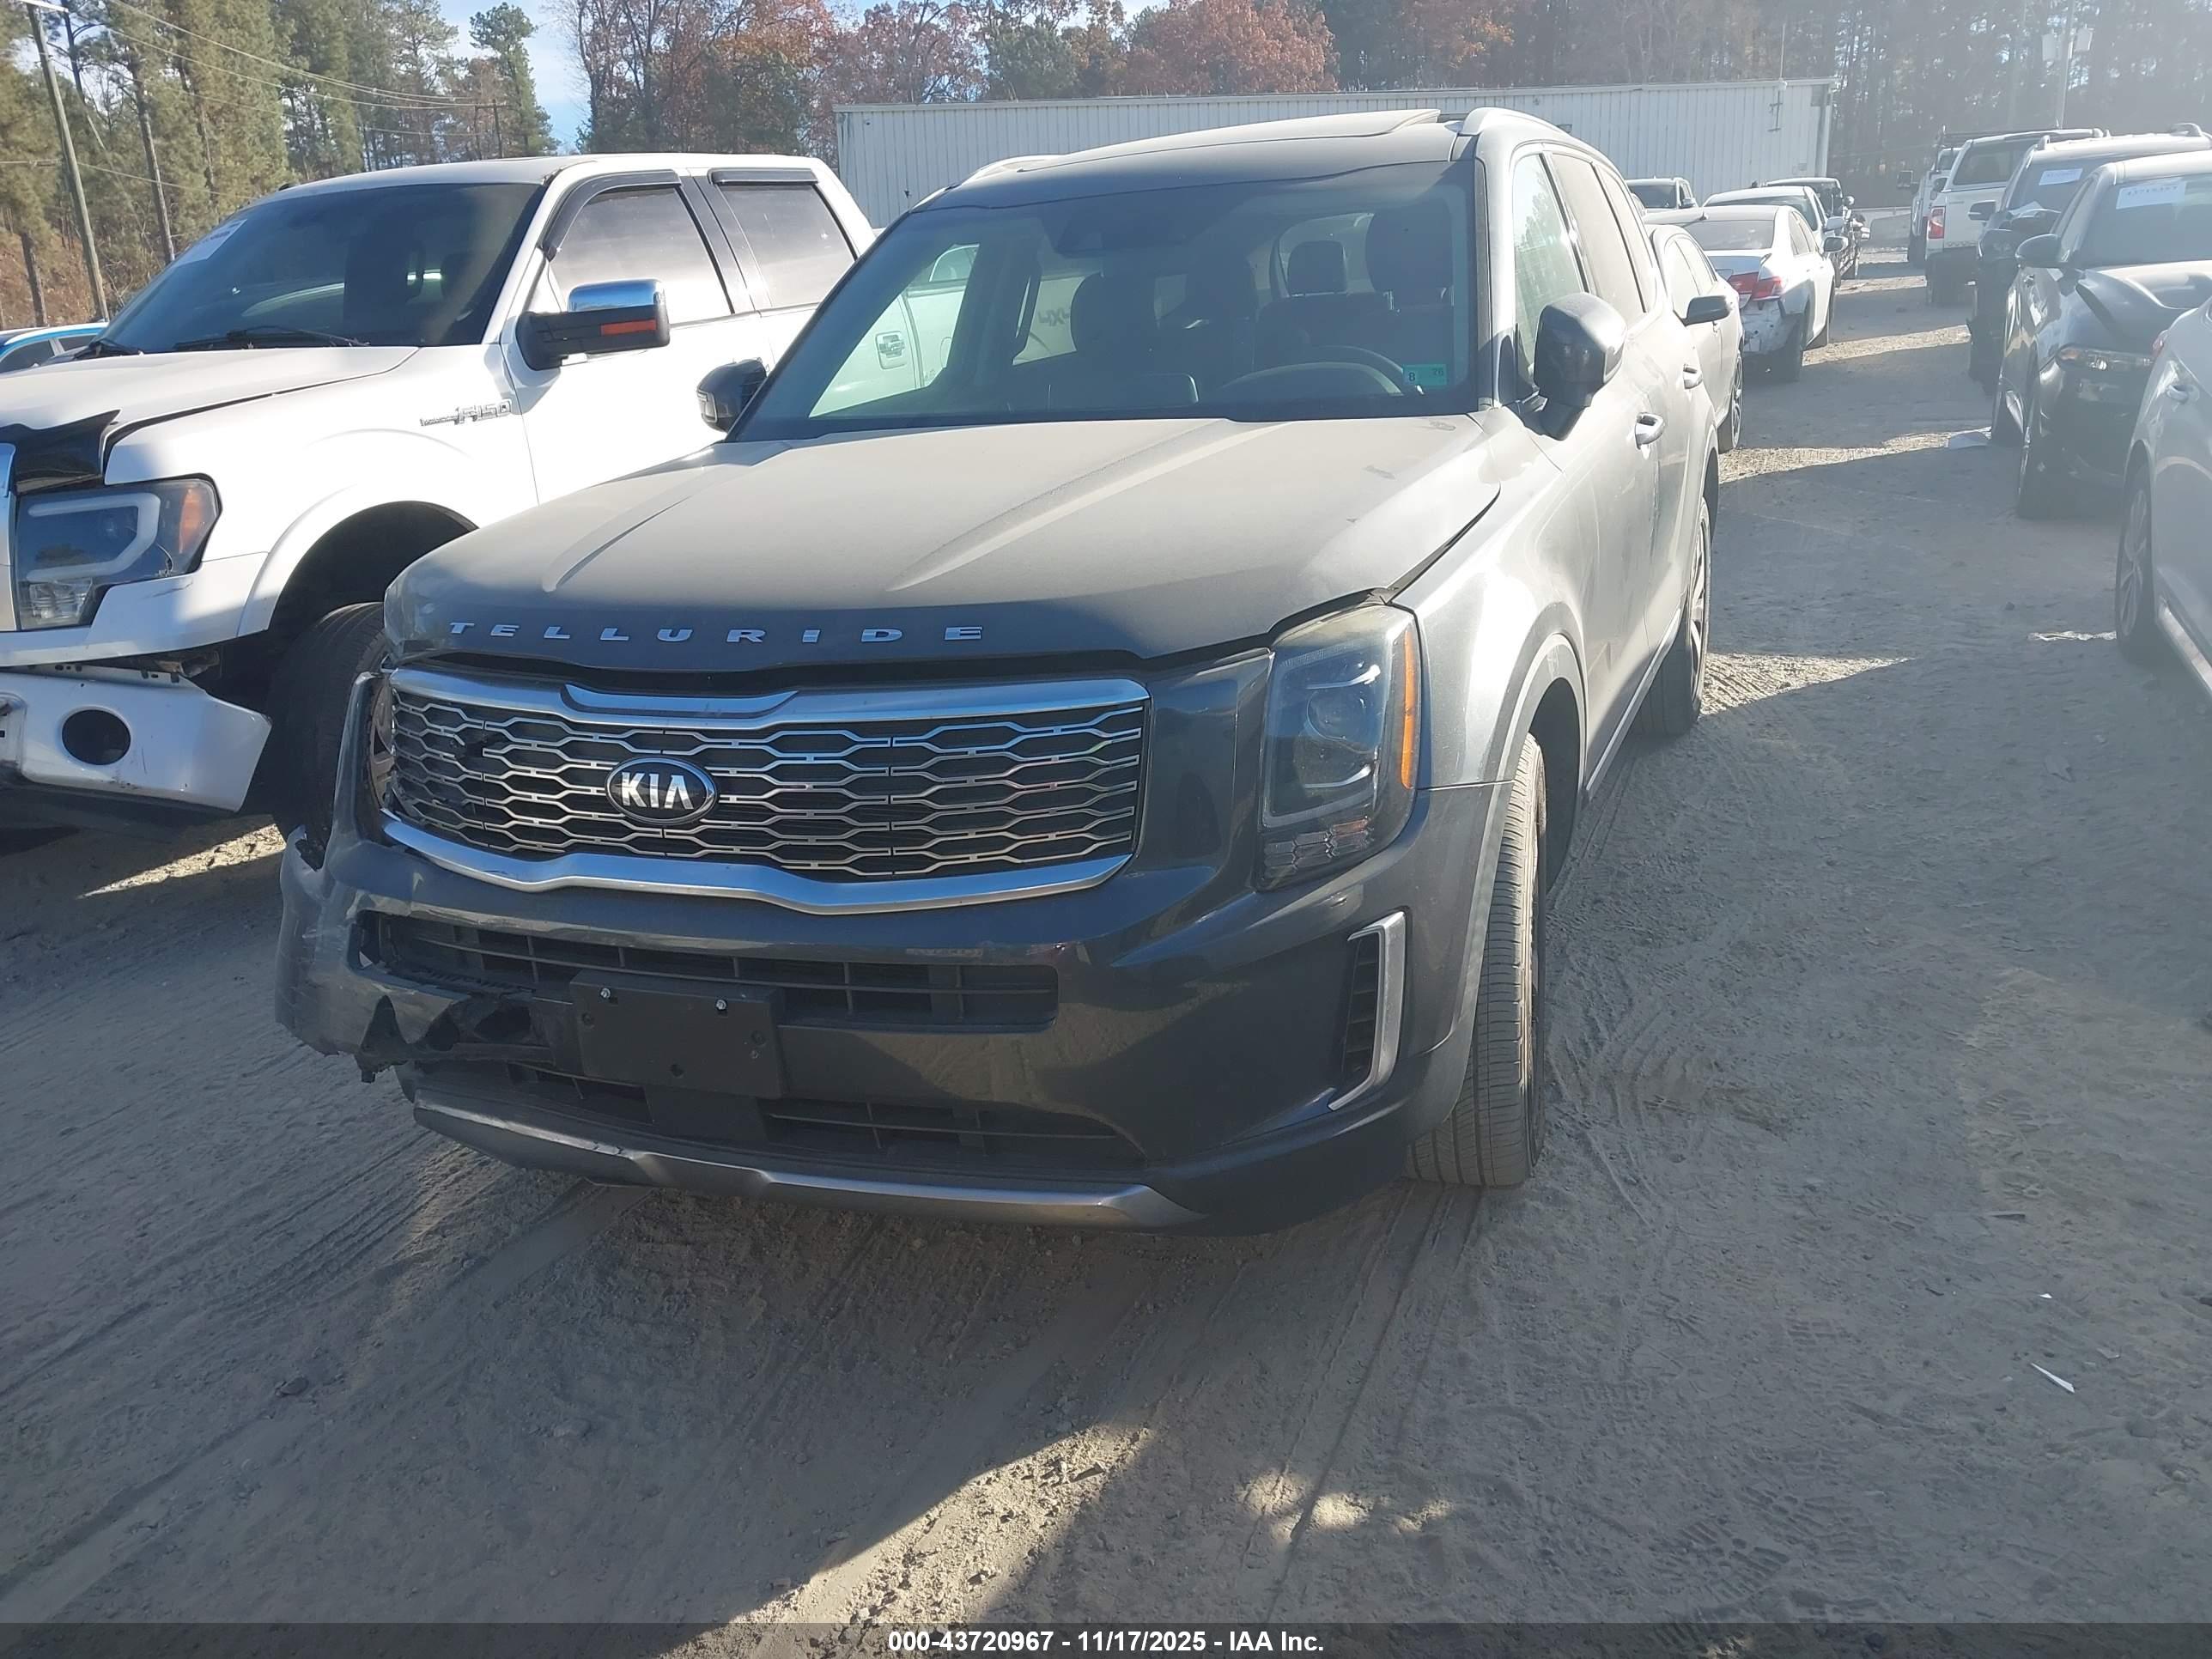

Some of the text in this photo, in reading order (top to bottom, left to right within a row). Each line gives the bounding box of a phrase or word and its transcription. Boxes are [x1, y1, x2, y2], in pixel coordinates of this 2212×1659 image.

[1408, 372, 1416, 382] 8
[449, 622, 983, 643] TELLURIDE
[621, 771, 695, 810] KIA
